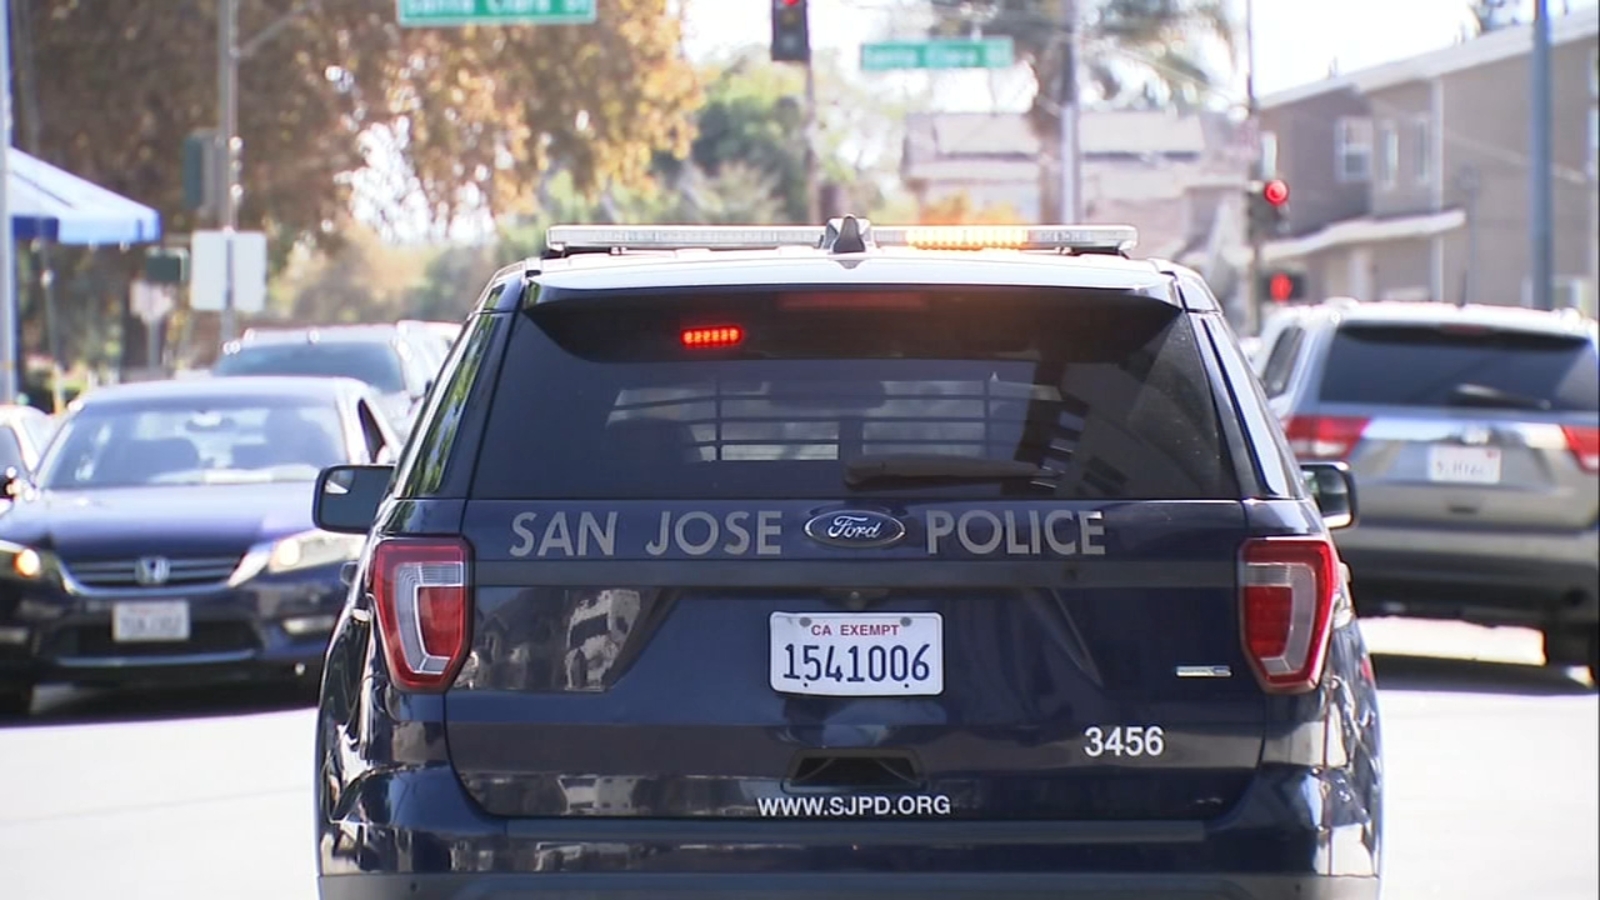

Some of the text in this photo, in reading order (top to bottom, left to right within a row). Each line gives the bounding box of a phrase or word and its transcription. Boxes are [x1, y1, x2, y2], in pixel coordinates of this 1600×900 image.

[509, 509, 1106, 556] SAN JOSE POLICE
[827, 515, 882, 538] Ford
[811, 624, 900, 636] CA EXEMPT
[783, 643, 930, 682] 1541006
[1084, 726, 1165, 757] 3456
[757, 796, 951, 817] WWW.SJPD.ORG
